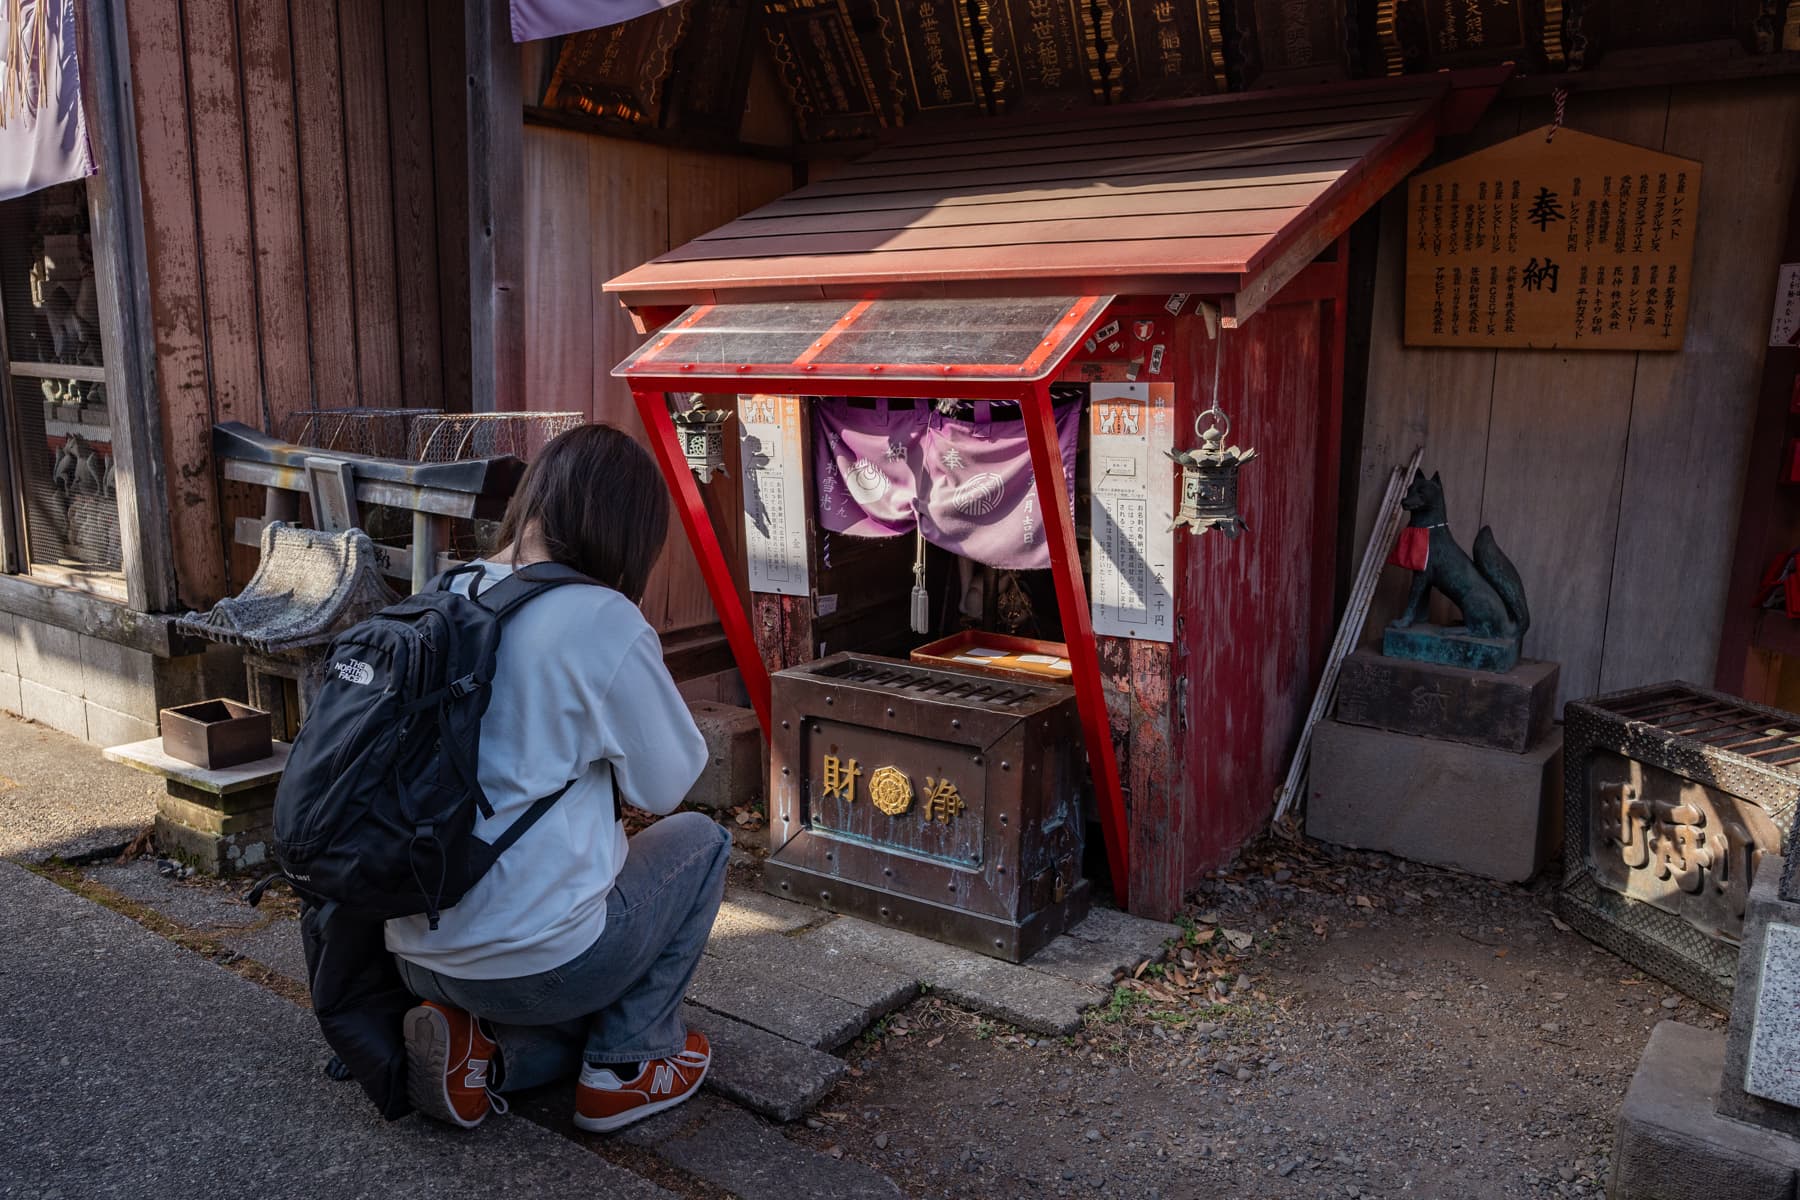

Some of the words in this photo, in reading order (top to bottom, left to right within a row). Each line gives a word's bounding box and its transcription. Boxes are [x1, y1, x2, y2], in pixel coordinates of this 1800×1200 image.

[884, 441, 908, 464] 納
[942, 447, 965, 471] 奉
[334, 661, 362, 677] NORTH
[349, 658, 368, 669] THE
[338, 671, 361, 683] FACE
[651, 1065, 675, 1094] N
